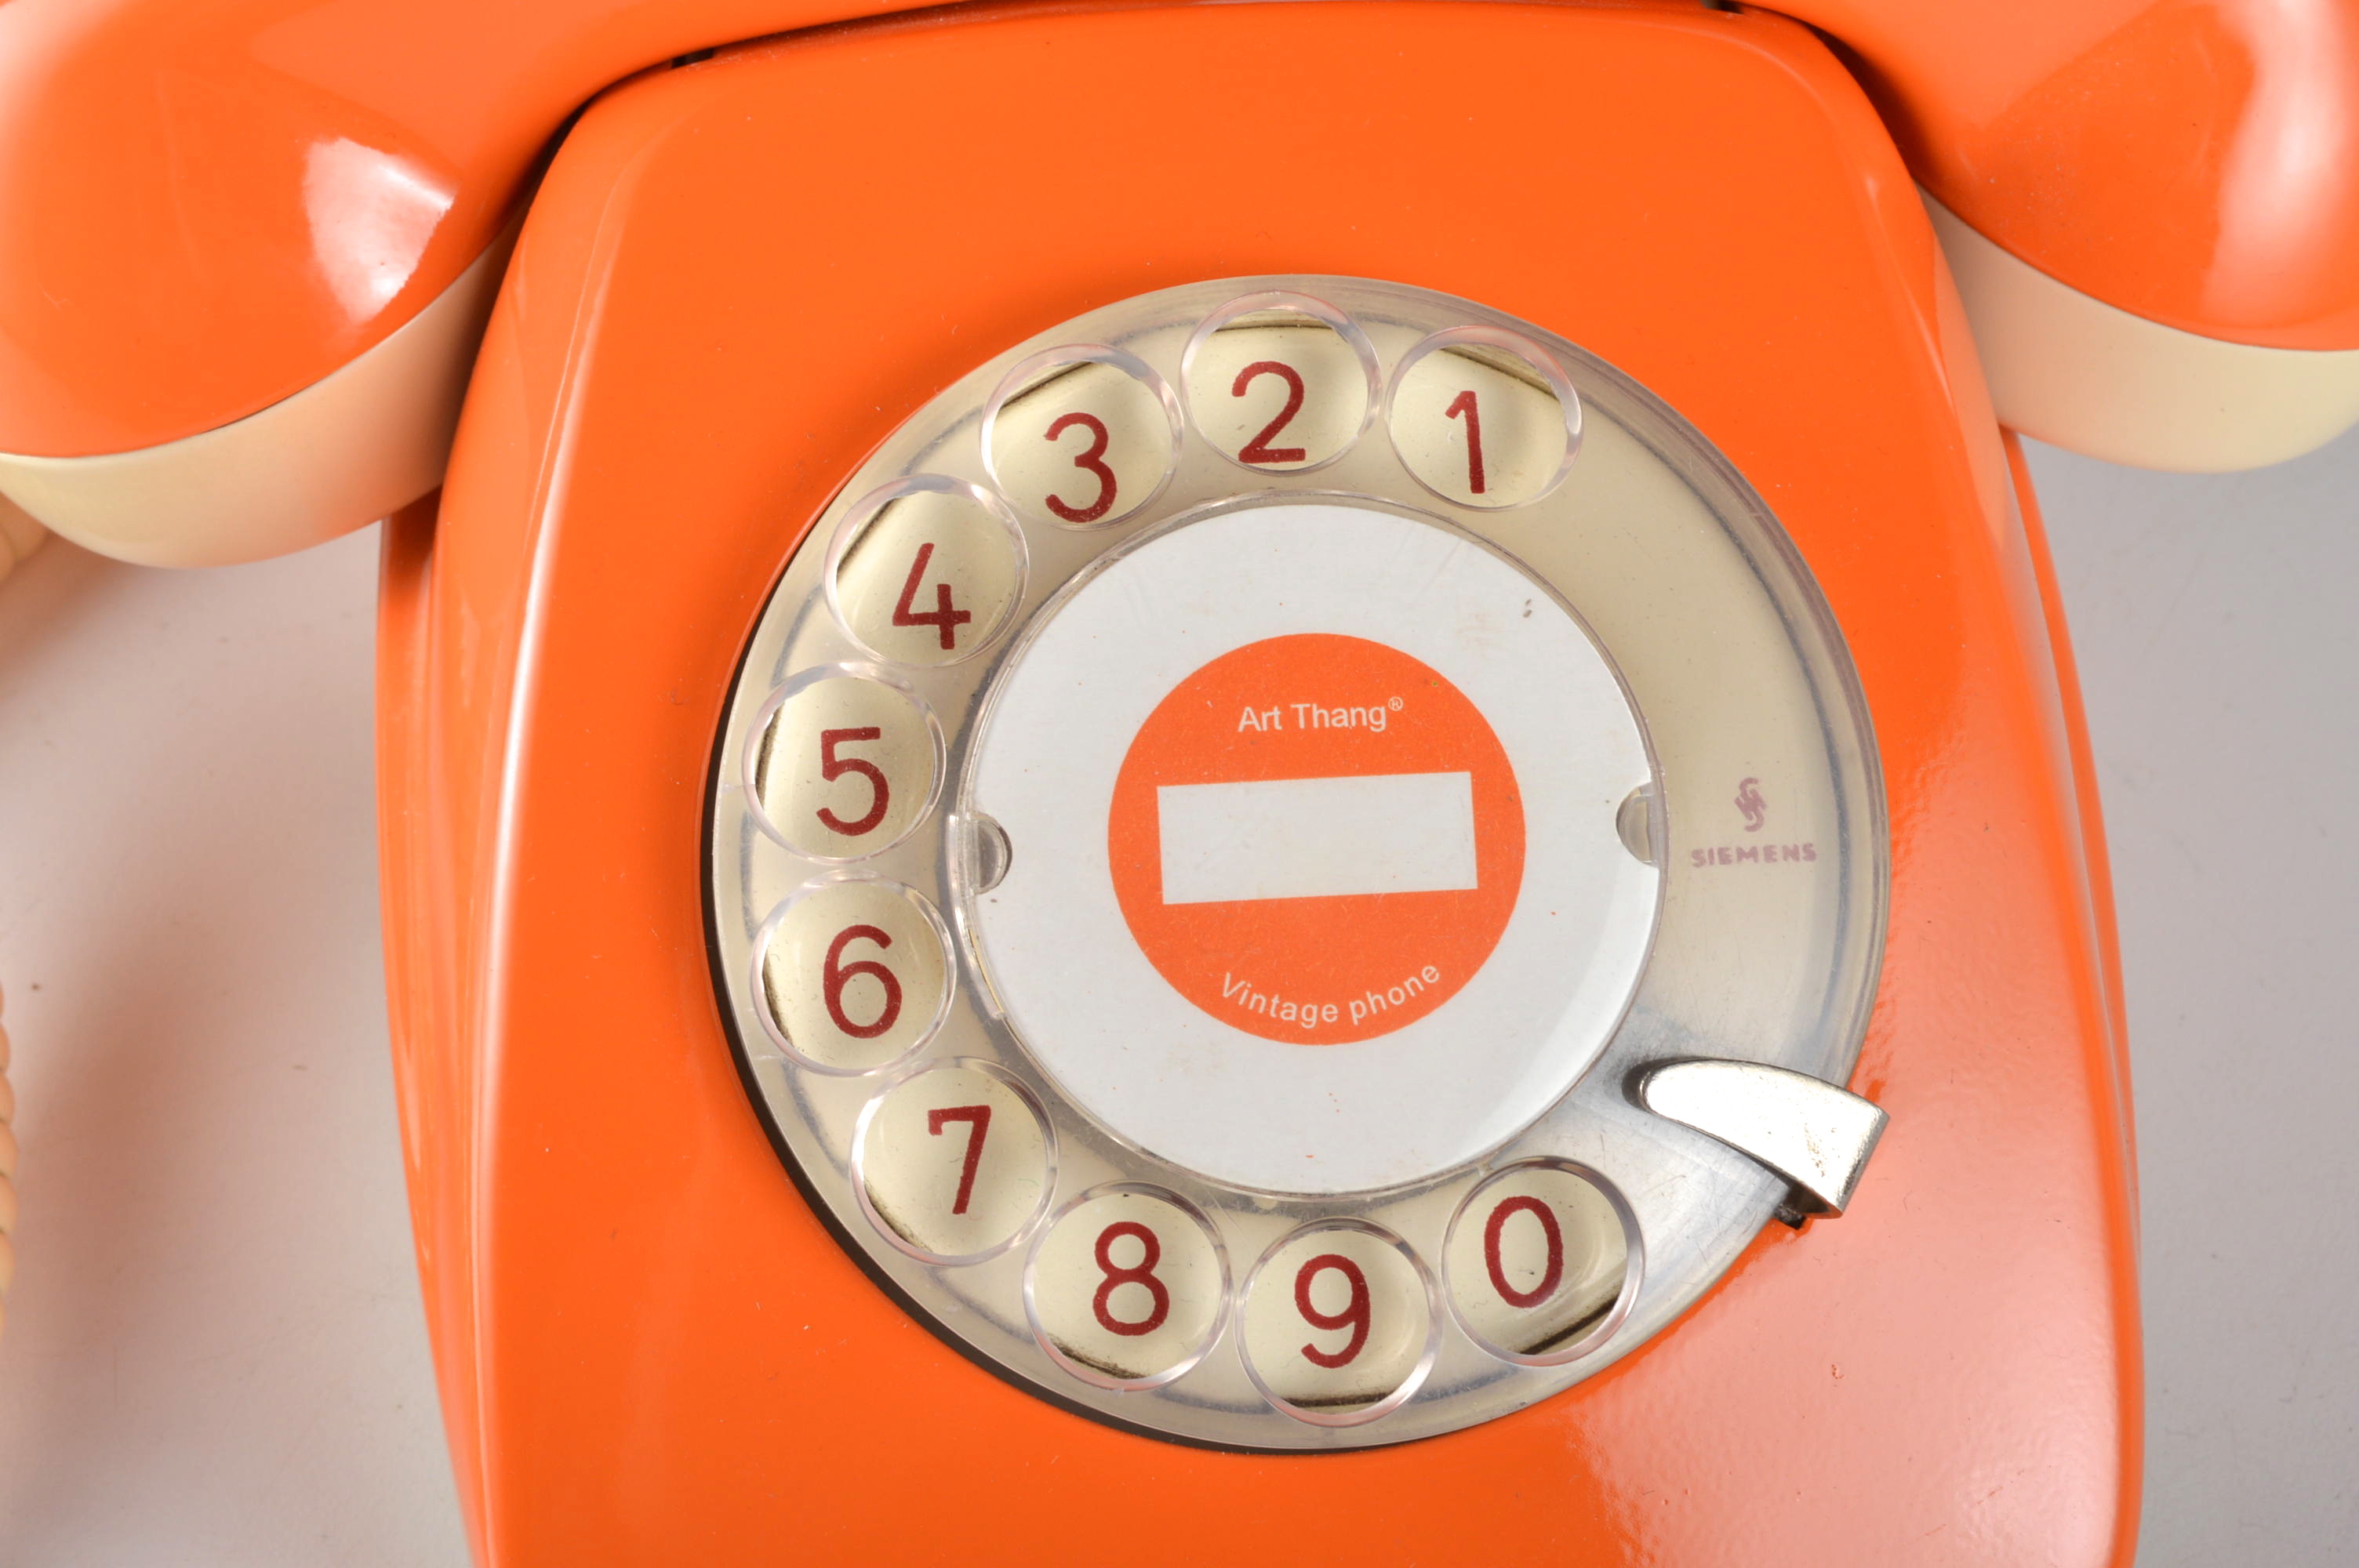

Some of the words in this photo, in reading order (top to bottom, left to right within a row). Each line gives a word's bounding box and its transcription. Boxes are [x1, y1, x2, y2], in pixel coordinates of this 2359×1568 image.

[1045, 412, 1118, 524] 3
[1233, 360, 1307, 465] 2
[1445, 390, 1486, 495] 1
[892, 542, 972, 651] 4
[1238, 706, 1283, 732] Art
[816, 726, 891, 837] 5
[1691, 842, 1817, 868] SIEMENS
[822, 924, 903, 1040] 6
[1221, 971, 1339, 1029] Vintage
[1349, 964, 1441, 1025] phone
[928, 1104, 993, 1215] 7
[1092, 1220, 1171, 1338] 8
[1483, 1195, 1565, 1308] 0
[1294, 1253, 1372, 1370] 9
